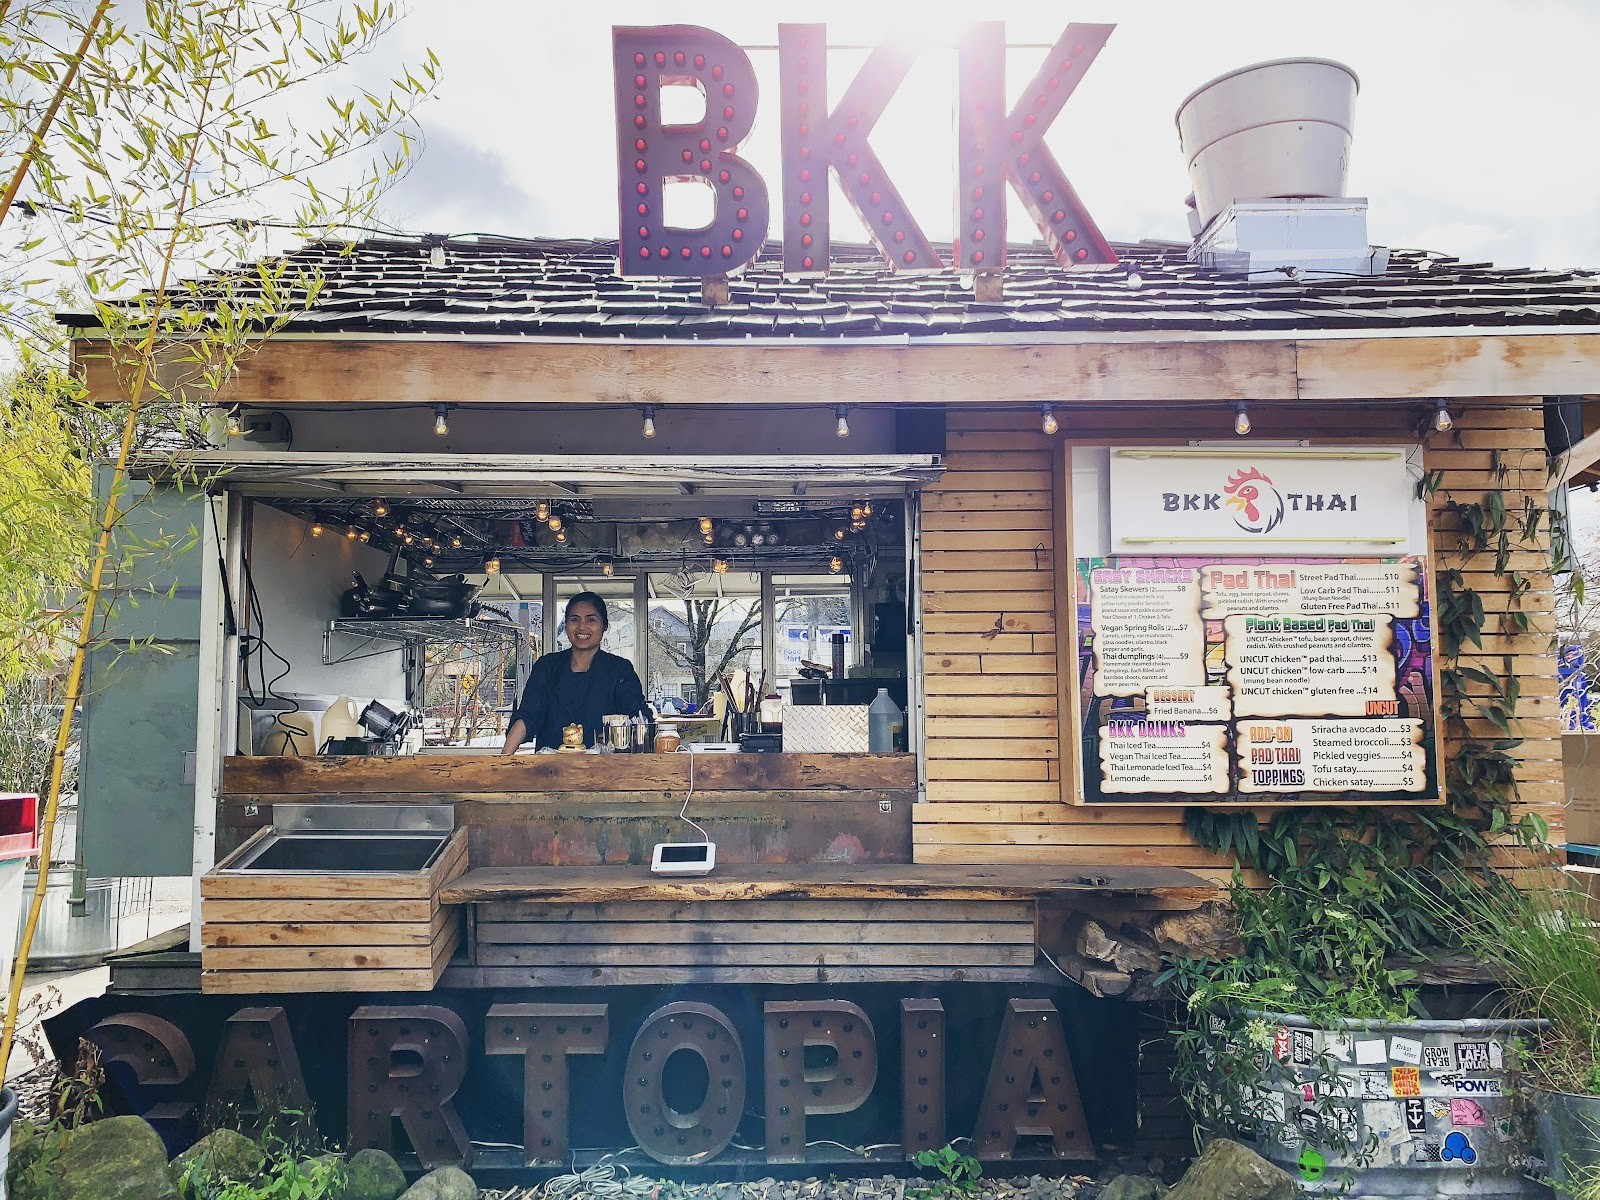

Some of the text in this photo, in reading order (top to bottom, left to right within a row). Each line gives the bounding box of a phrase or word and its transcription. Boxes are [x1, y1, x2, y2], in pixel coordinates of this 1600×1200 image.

[612, 20, 1120, 277] BKK
[1162, 492, 1357, 512] BKK THAI
[1094, 569, 1193, 584] EASY SNACKS
[1210, 570, 1297, 589] Pad Thai
[1100, 586, 1119, 594] Satay
[1300, 587, 1316, 595] Low
[1353, 586, 1369, 594] Thai
[1385, 586, 1400, 594] $11
[1300, 602, 1326, 610] Gluten
[1328, 602, 1345, 610] Free
[1101, 624, 1123, 633] Vegan
[1124, 624, 1147, 633] Spring
[1245, 617, 1375, 633] Plant Based Pad Thai
[1118, 652, 1155, 661] dumplings
[1180, 652, 1189, 660] $9
[1240, 655, 1269, 663] UNCUT
[1309, 655, 1325, 664] pad
[1326, 655, 1342, 663] thai
[1362, 654, 1378, 663] $13
[1240, 667, 1269, 675] UNCUT
[1309, 666, 1345, 674] low-carb
[1244, 677, 1265, 685] (mung
[1154, 690, 1195, 703] DESSERT
[1310, 687, 1337, 696] gluten
[1338, 687, 1355, 695] free
[1154, 707, 1218, 716] Fried Banana $6
[1365, 701, 1400, 715] UNCUT
[1108, 720, 1186, 738] BKK DRINKS
[1312, 724, 1411, 734] Sriracha avocado $3
[1250, 726, 1292, 743] ADD-ON
[1201, 741, 1210, 750] $4
[1313, 737, 1412, 747] Steamed broccoli $3
[1109, 753, 1134, 762] Vegan
[1202, 752, 1211, 761] $4
[1251, 747, 1301, 764] PAD THAI
[1313, 751, 1412, 761] Pickled veggies $4
[1127, 763, 1165, 771] Lemonade
[1165, 763, 1181, 771] Iced
[1202, 763, 1212, 772] $4
[1312, 764, 1413, 775] Tofu satay $4
[1110, 774, 1212, 782] Lemonade $4
[1251, 769, 1305, 786] TOPPINGS
[1313, 777, 1414, 788] Chicken satay $5
[1425, 1047, 1449, 1058] GROW
[1459, 1050, 1489, 1061] LAFA
[88, 997, 1096, 1166] CARTOPIA
[1456, 1080, 1488, 1092] POW
